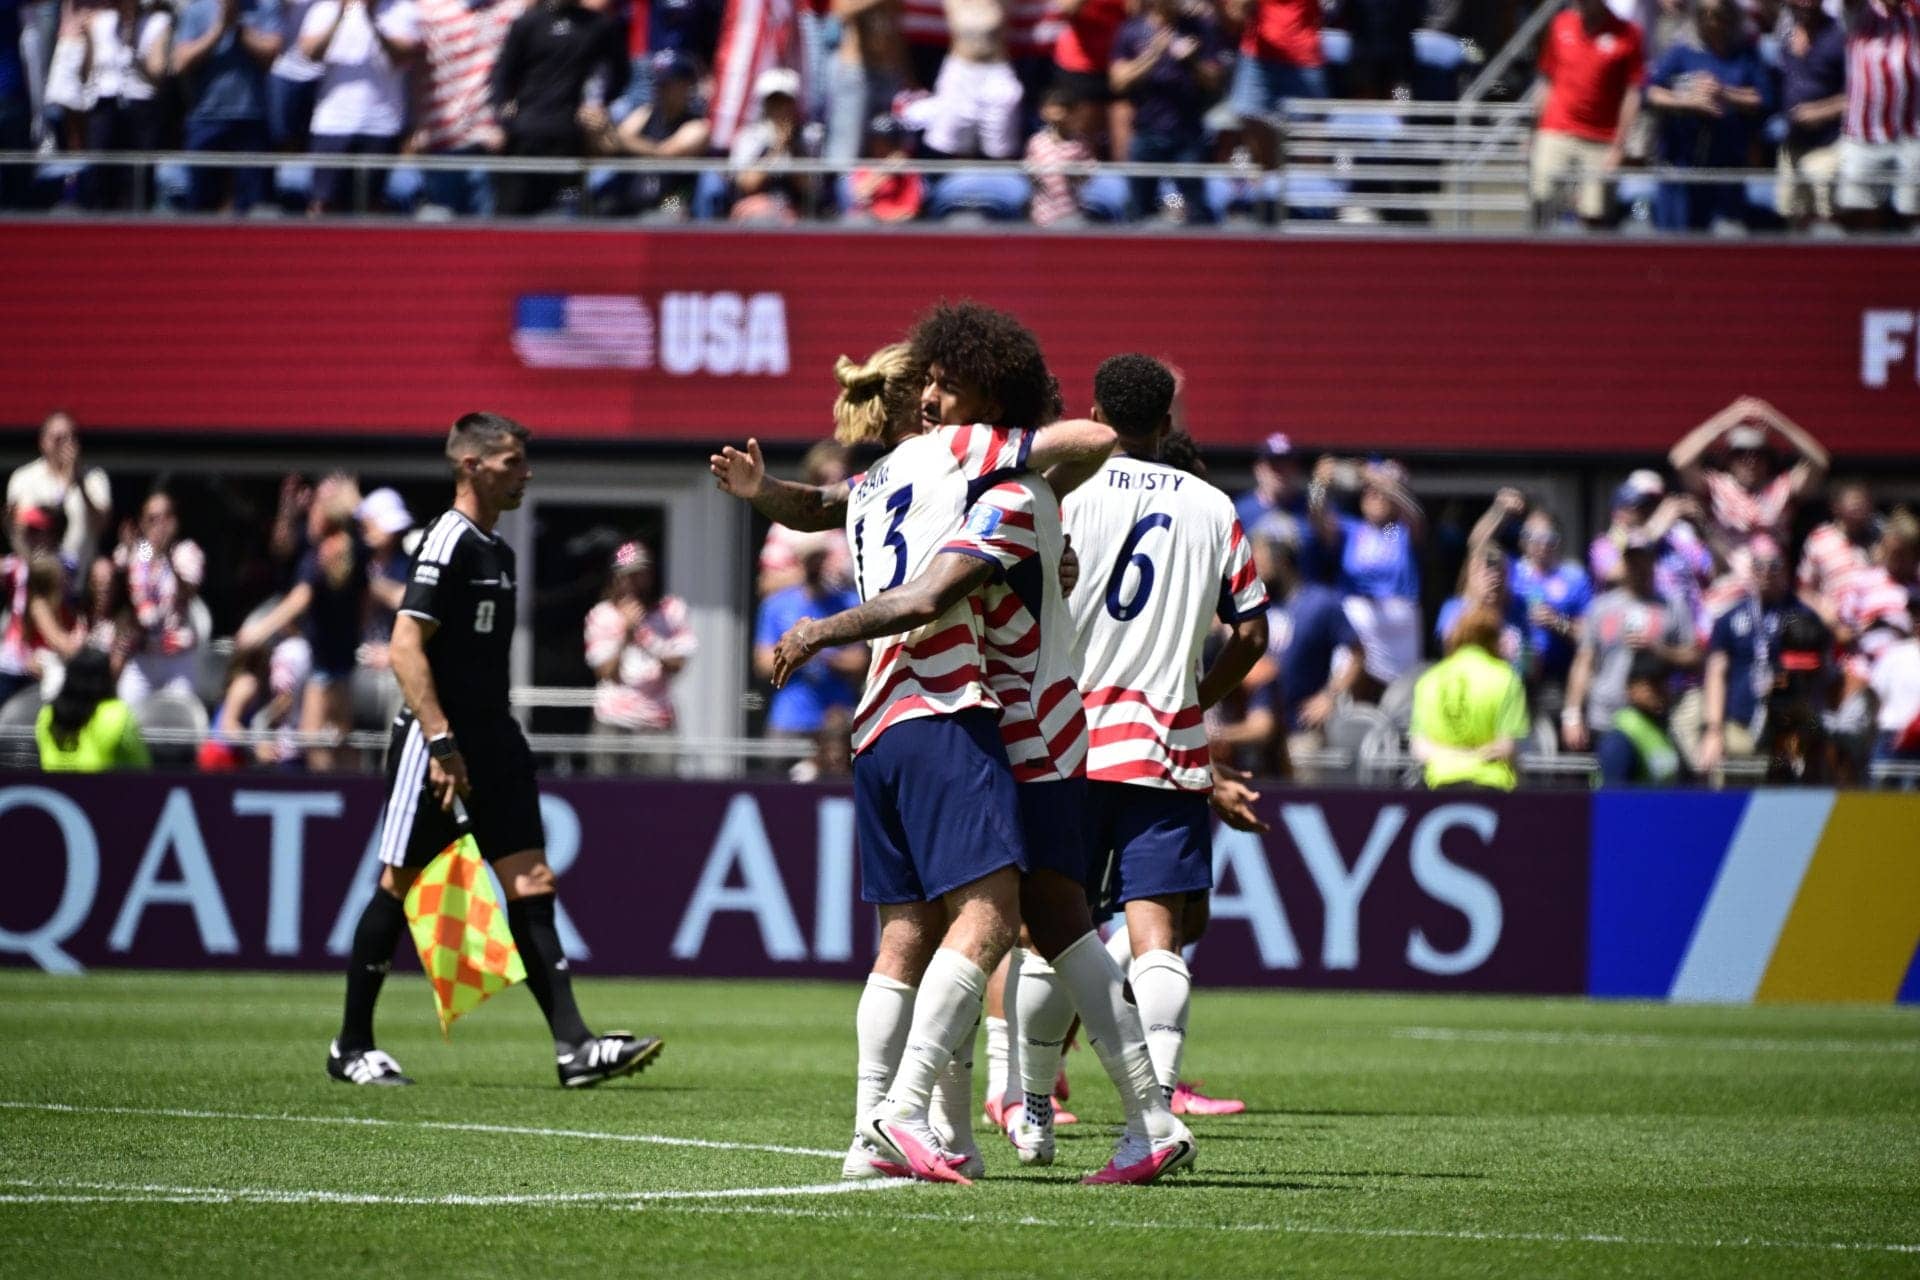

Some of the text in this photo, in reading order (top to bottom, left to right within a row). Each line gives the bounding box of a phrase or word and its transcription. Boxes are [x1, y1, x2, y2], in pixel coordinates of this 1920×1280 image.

[660, 291, 790, 376] USA
[1861, 308, 1920, 388] F
[1107, 469, 1184, 492] TRUSTY
[854, 482, 913, 602] 13
[1105, 512, 1173, 622] 6
[670, 793, 1503, 976] AIAYS
